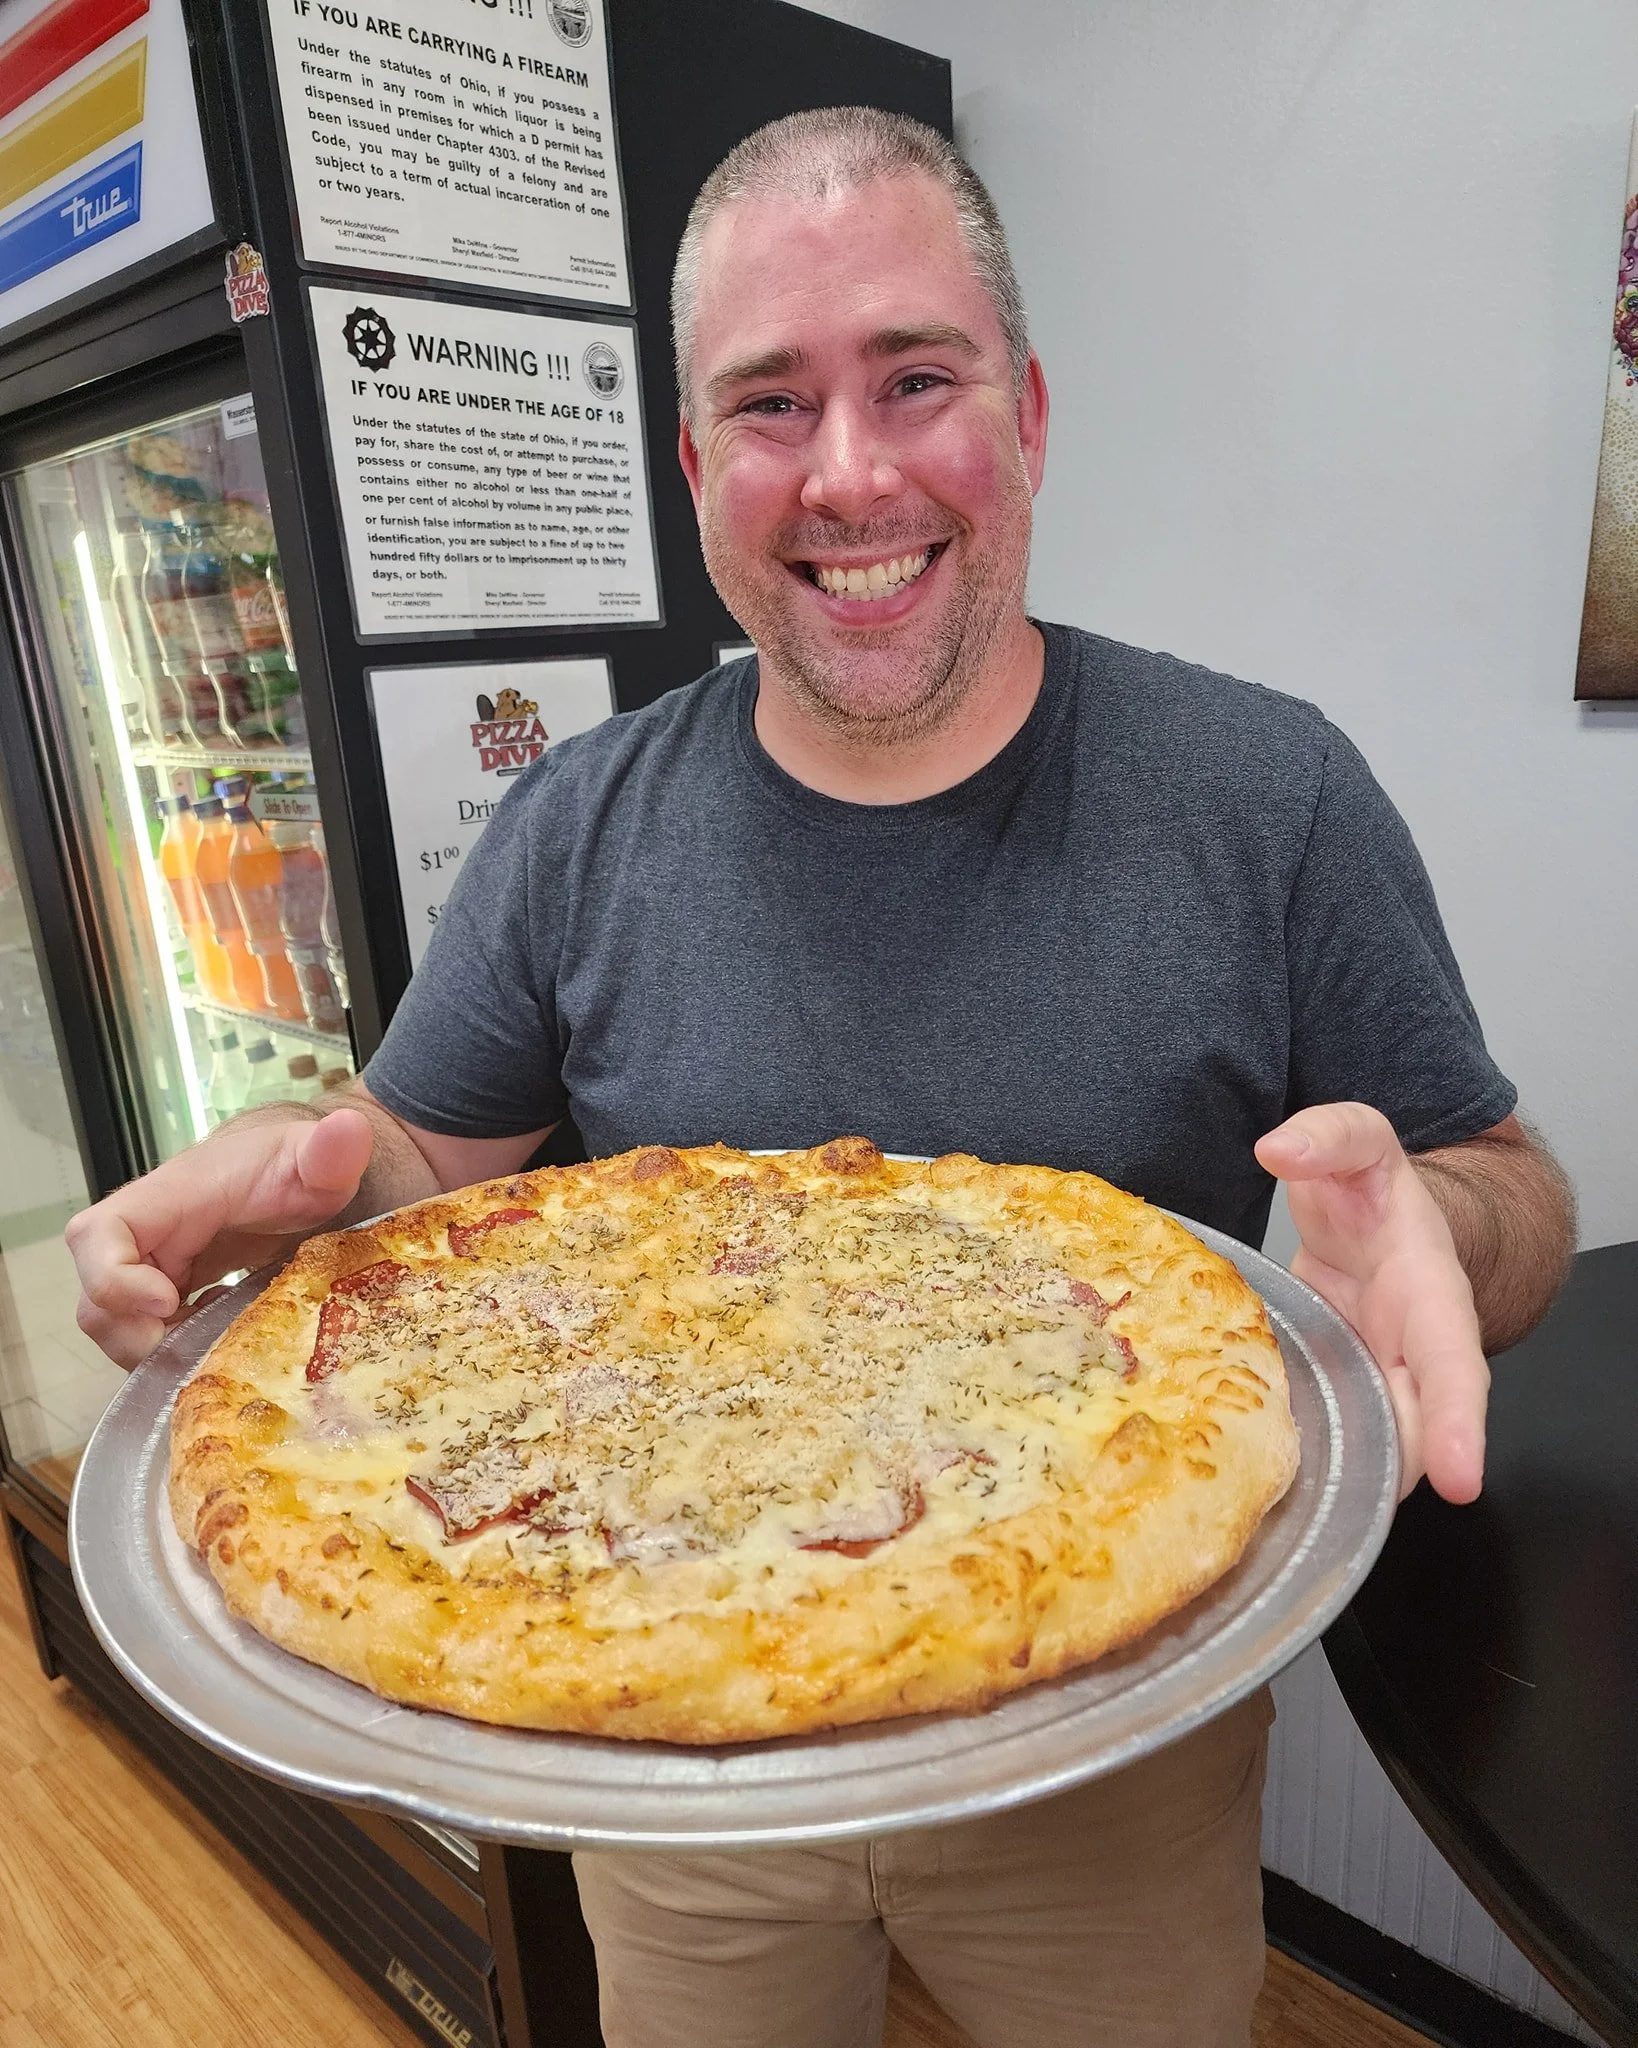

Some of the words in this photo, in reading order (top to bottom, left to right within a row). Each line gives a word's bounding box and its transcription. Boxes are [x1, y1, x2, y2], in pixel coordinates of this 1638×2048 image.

[293, 0, 310, 17] IF
[317, 3, 358, 29] YOU
[365, 16, 403, 40] ARE
[408, 27, 497, 64] CARRYING
[502, 52, 513, 69] A
[518, 55, 589, 88] FIREARM
[297, 37, 340, 58] Under
[348, 49, 371, 65] the
[379, 58, 432, 80] statutes
[440, 73, 451, 85] of
[459, 76, 491, 97] Ohio,
[497, 85, 506, 98] if
[513, 92, 534, 104] you
[542, 98, 586, 117] possess
[592, 111, 600, 120] a
[300, 60, 353, 83] firearm
[361, 73, 374, 88] in
[383, 81, 406, 98] any
[414, 88, 446, 105] room
[453, 95, 465, 109] in
[472, 102, 508, 119] which
[515, 110, 548, 127] liquor
[555, 118, 565, 132] is
[571, 123, 602, 143] being
[304, 84, 374, 110] dispensed
[379, 99, 392, 114] in
[397, 106, 454, 127] premises
[458, 117, 475, 132] for
[479, 124, 514, 141] which
[519, 134, 526, 143] a
[531, 133, 539, 145] D
[544, 139, 580, 155] permit
[584, 145, 604, 160] has
[307, 106, 342, 125] been
[347, 114, 391, 135] issued
[396, 127, 432, 143] under
[436, 134, 484, 154] Chapter
[524, 153, 536, 165] of
[541, 156, 559, 170] the
[564, 160, 606, 179] Revised
[311, 130, 351, 152] Code,
[359, 142, 383, 155] you
[391, 148, 418, 164] may
[425, 152, 440, 166] be
[448, 160, 481, 177] guilty
[489, 166, 500, 178] of
[508, 172, 515, 181] a
[522, 172, 556, 191] felony
[563, 182, 584, 194] and
[590, 188, 608, 199] are
[315, 155, 366, 174] subject
[370, 163, 384, 177] to
[389, 169, 398, 179] a
[402, 169, 432, 186] term
[437, 177, 448, 189] of
[454, 182, 491, 197] actual
[495, 186, 571, 211] incarceration
[575, 202, 586, 214] of
[590, 207, 610, 218] one
[318, 178, 332, 189] or
[336, 179, 361, 194] two
[365, 186, 405, 202] years.
[60, 186, 129, 238] true
[228, 270, 267, 299] PIZZA
[233, 291, 268, 318] DIVE
[407, 333, 538, 377] WARNING
[547, 353, 570, 381] !!!
[351, 379, 367, 396] IF
[373, 382, 411, 401] YOU
[417, 387, 451, 405] ARE
[456, 392, 511, 412] UNDER
[515, 399, 546, 416] THE
[550, 403, 581, 420] AGE
[585, 407, 603, 422] OF
[608, 410, 624, 424] 18
[352, 414, 388, 429] Under
[392, 419, 411, 431] the
[416, 422, 462, 435] statutes
[465, 426, 476, 437] of
[479, 427, 497, 439] the
[500, 431, 526, 442] state
[529, 433, 539, 443] of
[543, 434, 568, 446] Ohio,
[354, 436, 376, 449] pay
[380, 436, 400, 450] for,
[403, 439, 435, 451] share
[439, 442, 457, 453] the
[460, 446, 484, 455] cost
[487, 446, 500, 458] of,
[503, 449, 513, 458] or
[517, 450, 555, 463] attempt
[558, 453, 569, 462] to
[572, 455, 617, 467] purchase,
[357, 456, 405, 468] possess
[410, 460, 422, 469] or
[427, 461, 479, 475] consume,
[483, 465, 502, 477] any
[506, 466, 528, 478] type
[532, 467, 542, 477] of
[546, 468, 568, 479] beer
[359, 475, 410, 486] contains
[416, 477, 448, 488] either
[454, 481, 468, 490] no
[472, 481, 510, 493] alcohol
[515, 485, 525, 494] or
[529, 484, 550, 495] less
[554, 487, 576, 496] than
[362, 494, 384, 503] one
[387, 495, 406, 506] per
[409, 496, 434, 506] cent
[437, 496, 448, 506] of
[451, 497, 489, 509] alcohol
[491, 499, 504, 512] by
[506, 501, 541, 512] volume
[555, 505, 573, 515] any
[365, 516, 377, 525] or
[380, 514, 420, 527] furnish
[423, 516, 450, 528] false
[452, 518, 512, 530] information
[514, 523, 526, 531] as
[528, 522, 538, 531] to
[367, 532, 445, 546] identification,
[448, 538, 467, 547] you
[470, 538, 487, 546] are
[489, 537, 526, 549] subject
[528, 538, 539, 548] to
[369, 550, 416, 562] hundred
[419, 552, 441, 565] fifty
[444, 552, 480, 563] dollars
[482, 555, 493, 563] or
[495, 554, 506, 564] to
[508, 554, 573, 566] imprisonment
[372, 569, 403, 582] days,
[419, 569, 447, 580] both.
[470, 718, 549, 748] PIZZA
